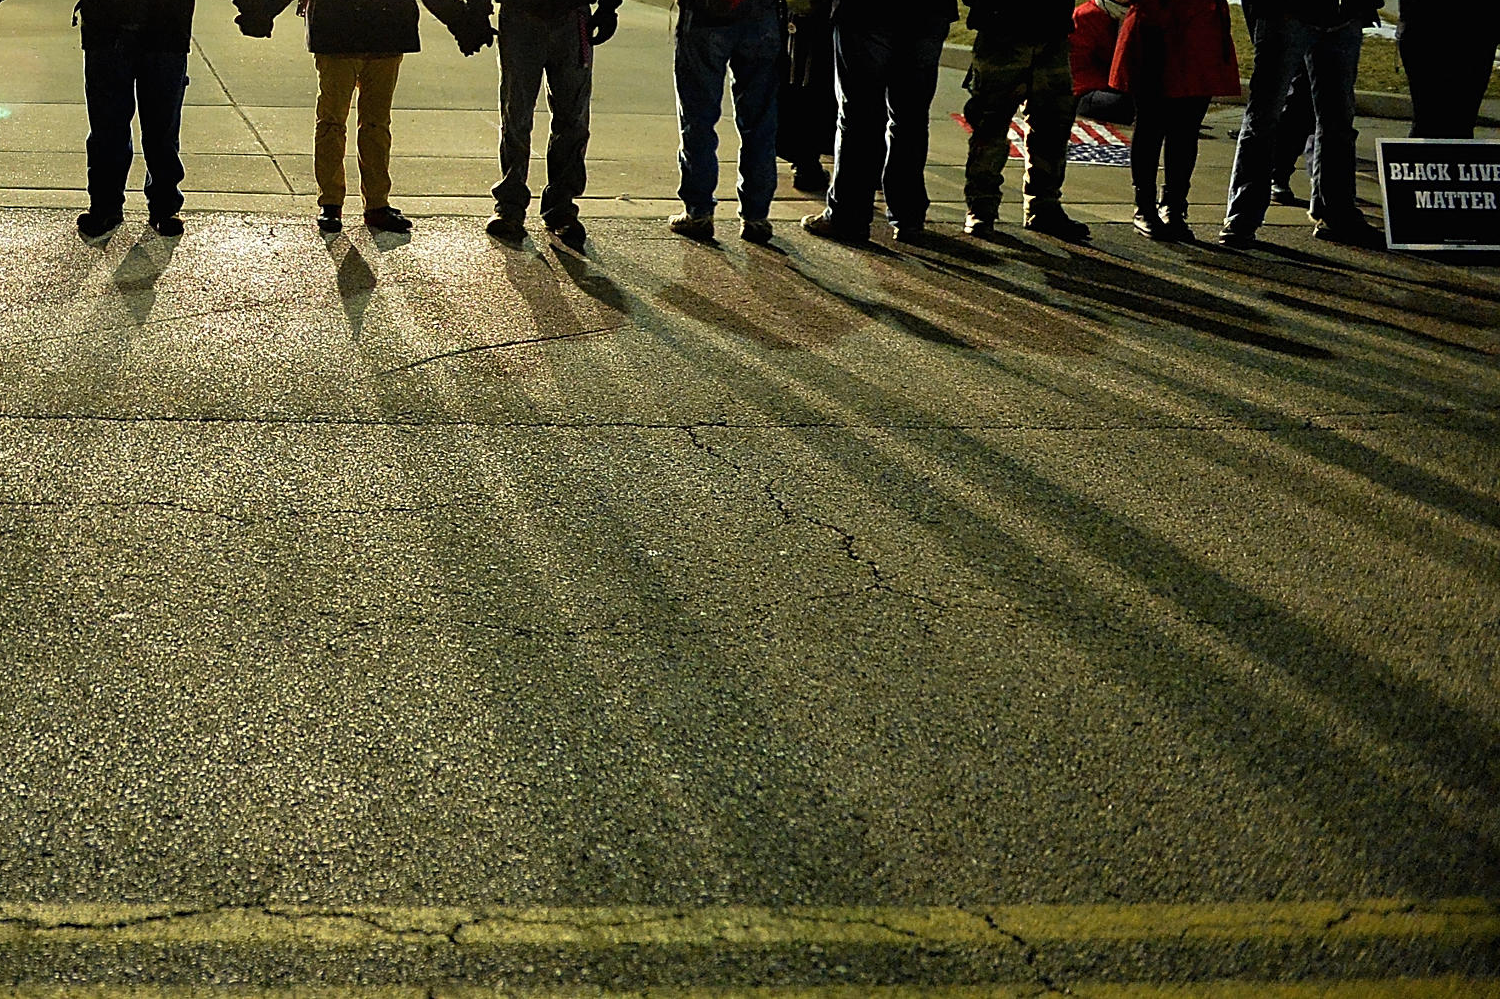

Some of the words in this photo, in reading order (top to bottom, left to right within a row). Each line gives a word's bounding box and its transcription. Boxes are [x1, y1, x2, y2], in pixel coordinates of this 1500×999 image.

[1389, 163, 1451, 181] BLACK
[1457, 163, 1500, 182] LIVE
[1415, 191, 1497, 209] MATTER
